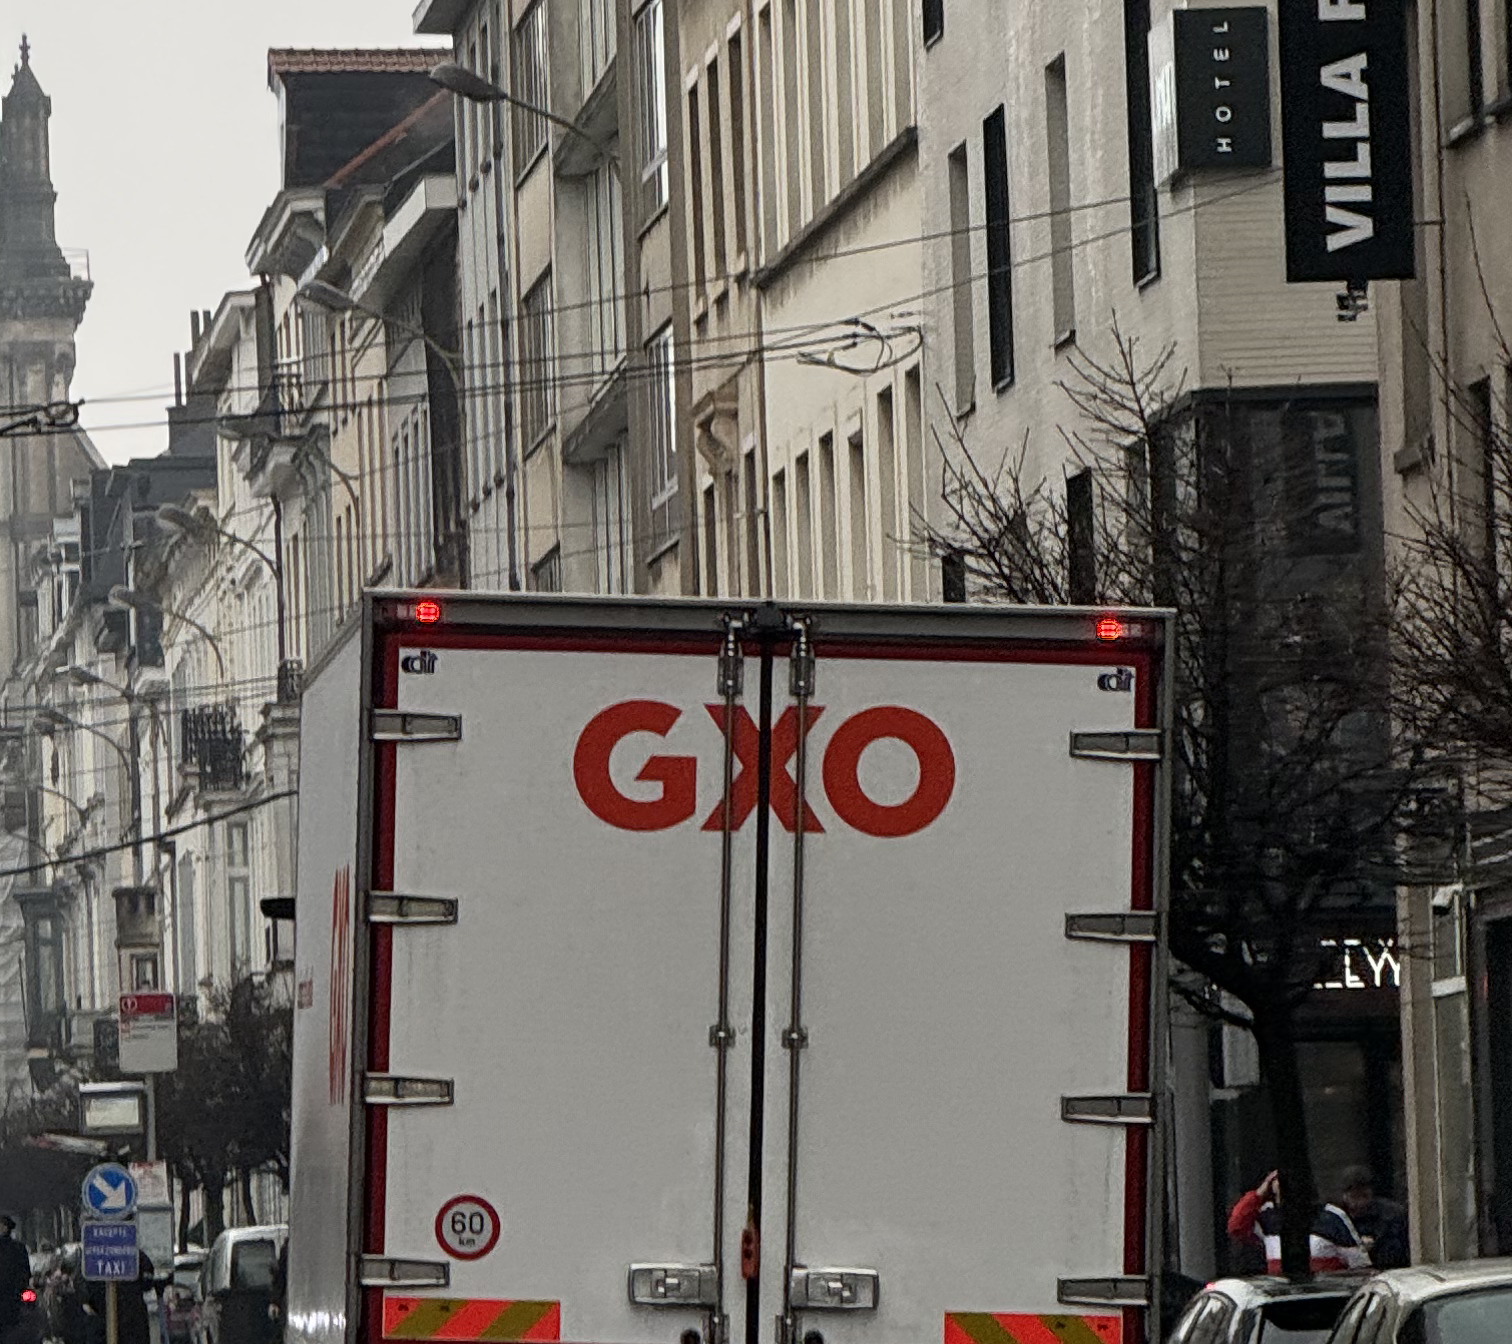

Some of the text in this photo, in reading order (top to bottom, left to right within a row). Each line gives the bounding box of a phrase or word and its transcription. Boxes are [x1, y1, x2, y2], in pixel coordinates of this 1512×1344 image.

[1212, 20, 1233, 153] HOTEL
[1320, 52, 1374, 253] VILLA
[573, 699, 955, 838] GXO
[98, 1259, 126, 1276] TAXI
[451, 1211, 484, 1235] 60
